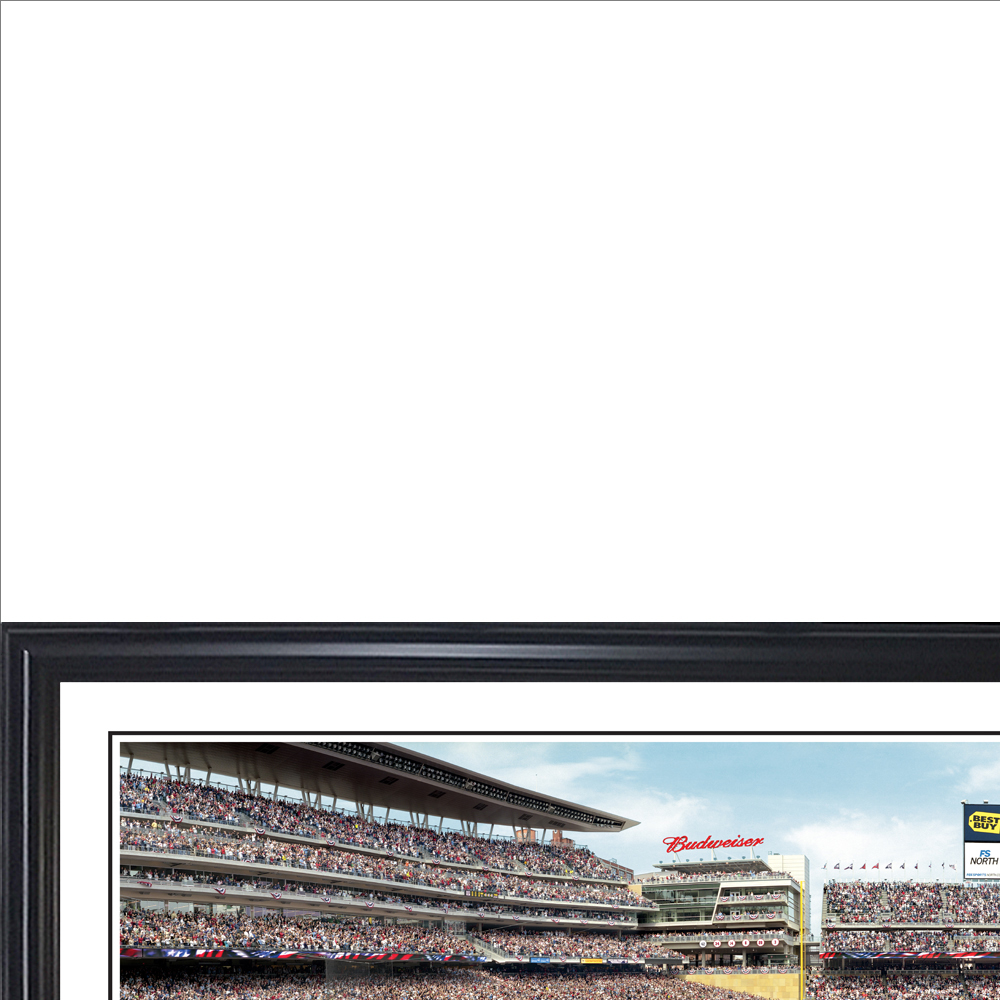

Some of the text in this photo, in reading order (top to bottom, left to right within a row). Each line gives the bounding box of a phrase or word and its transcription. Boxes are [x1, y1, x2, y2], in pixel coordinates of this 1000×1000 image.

[973, 815, 1000, 824] BEST
[973, 821, 997, 830] BUY
[662, 834, 765, 853] Budweiser
[979, 849, 991, 857] FS
[969, 857, 999, 866] NORTH
